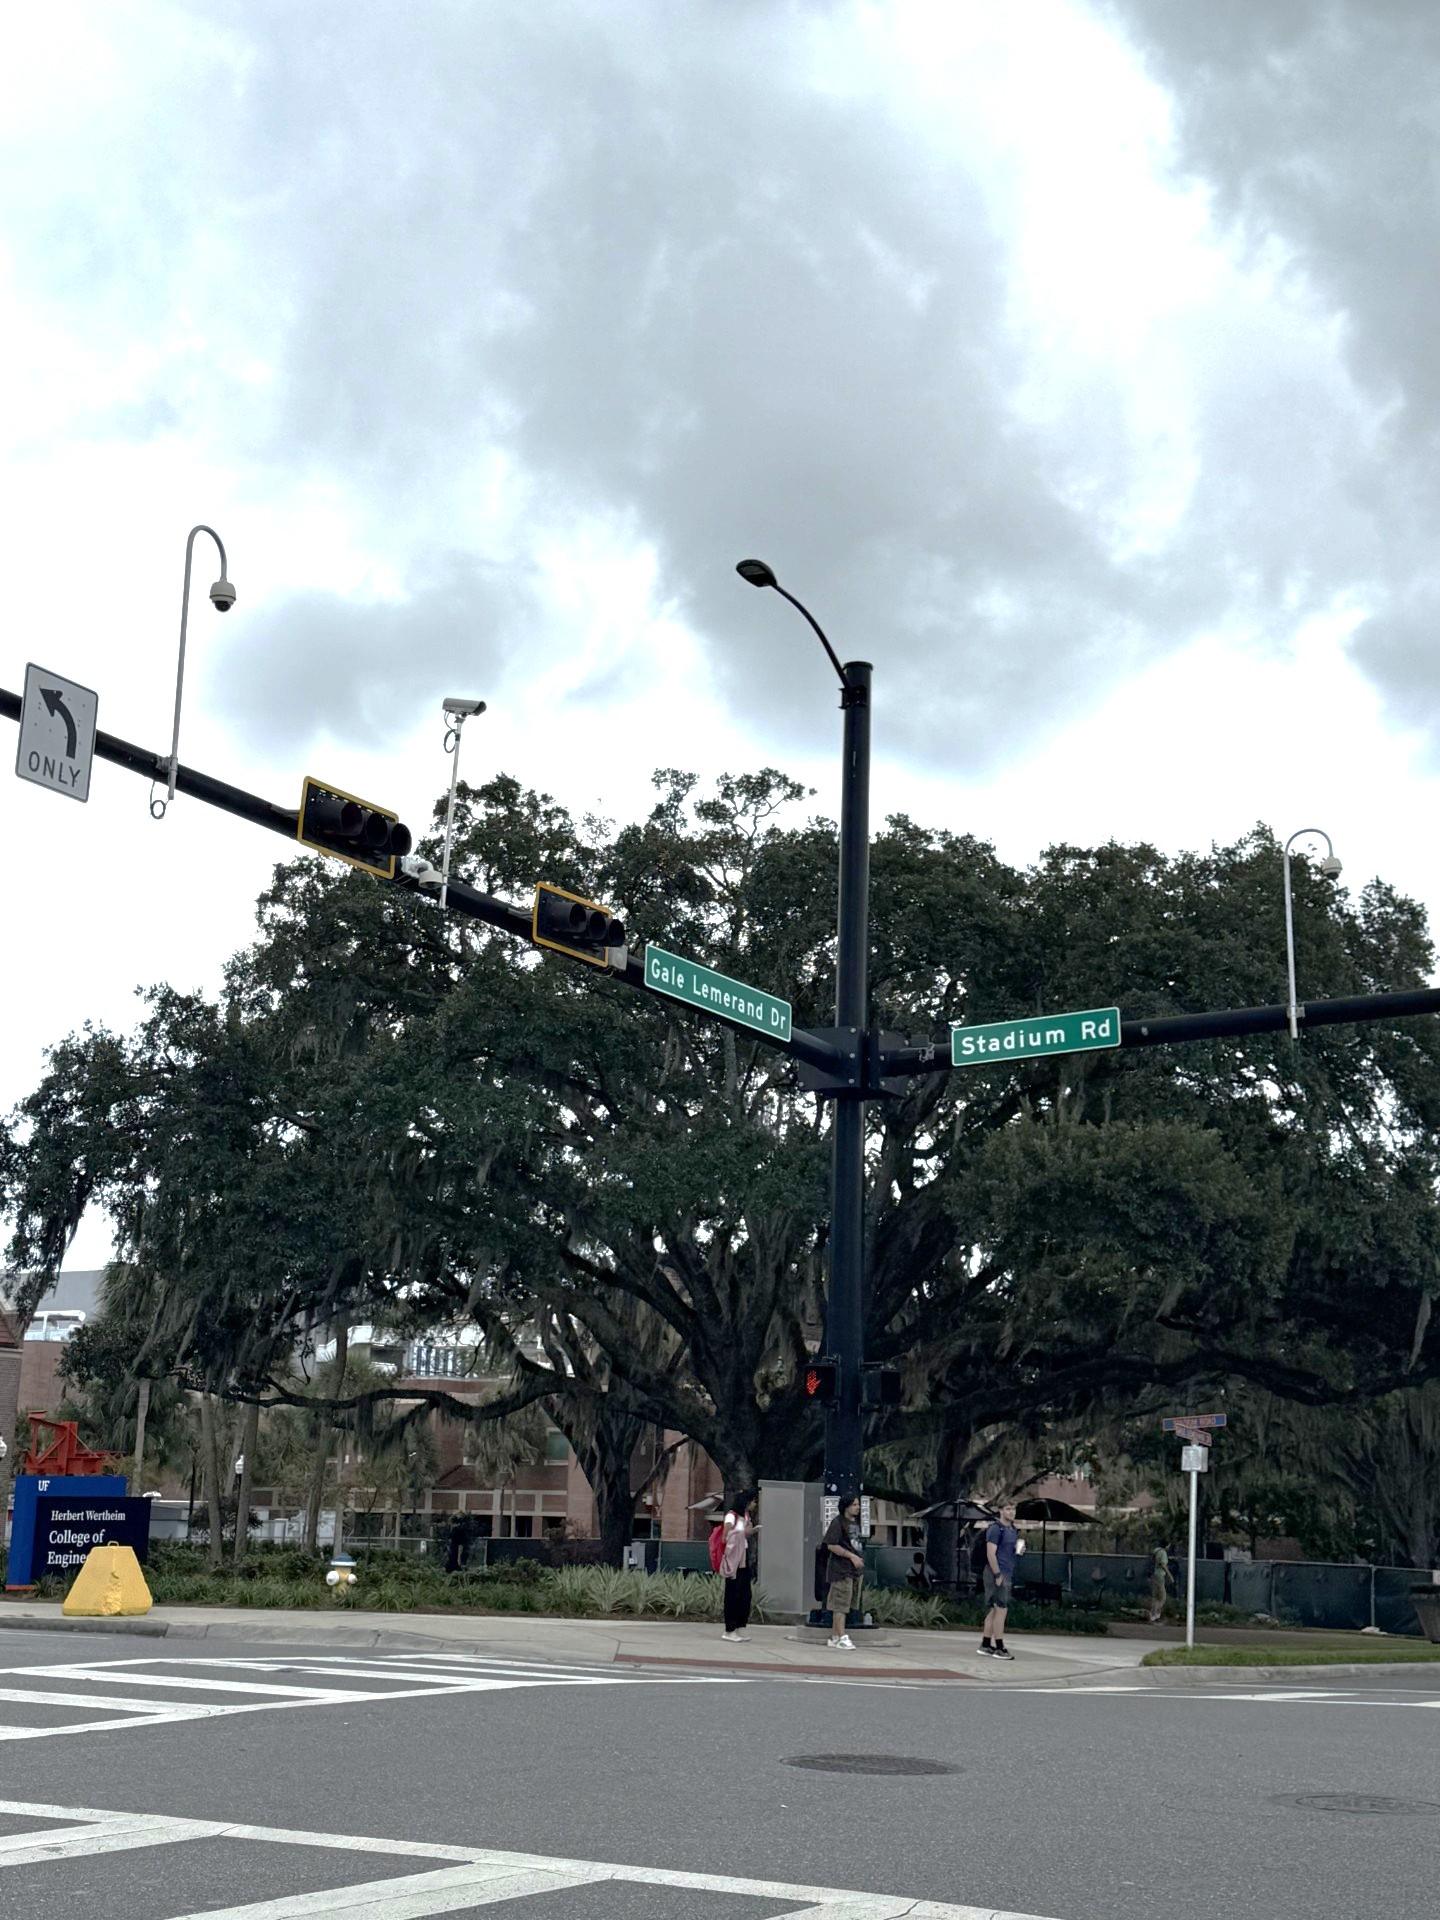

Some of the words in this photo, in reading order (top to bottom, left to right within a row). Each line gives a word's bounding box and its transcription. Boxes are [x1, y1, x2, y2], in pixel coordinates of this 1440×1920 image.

[28, 750, 81, 788] ONLY
[651, 958, 685, 989] Gale
[693, 974, 763, 1021] Lemerand
[771, 1007, 786, 1030] Dr
[961, 1029, 1065, 1055] Stadium
[1082, 1018, 1111, 1040] Rd
[38, 1480, 51, 1492] UF
[51, 1510, 85, 1522] Herbert
[85, 1510, 126, 1522] Wertheim
[49, 1530, 91, 1547] College
[92, 1528, 106, 1543] of
[46, 1550, 88, 1568] Engine
